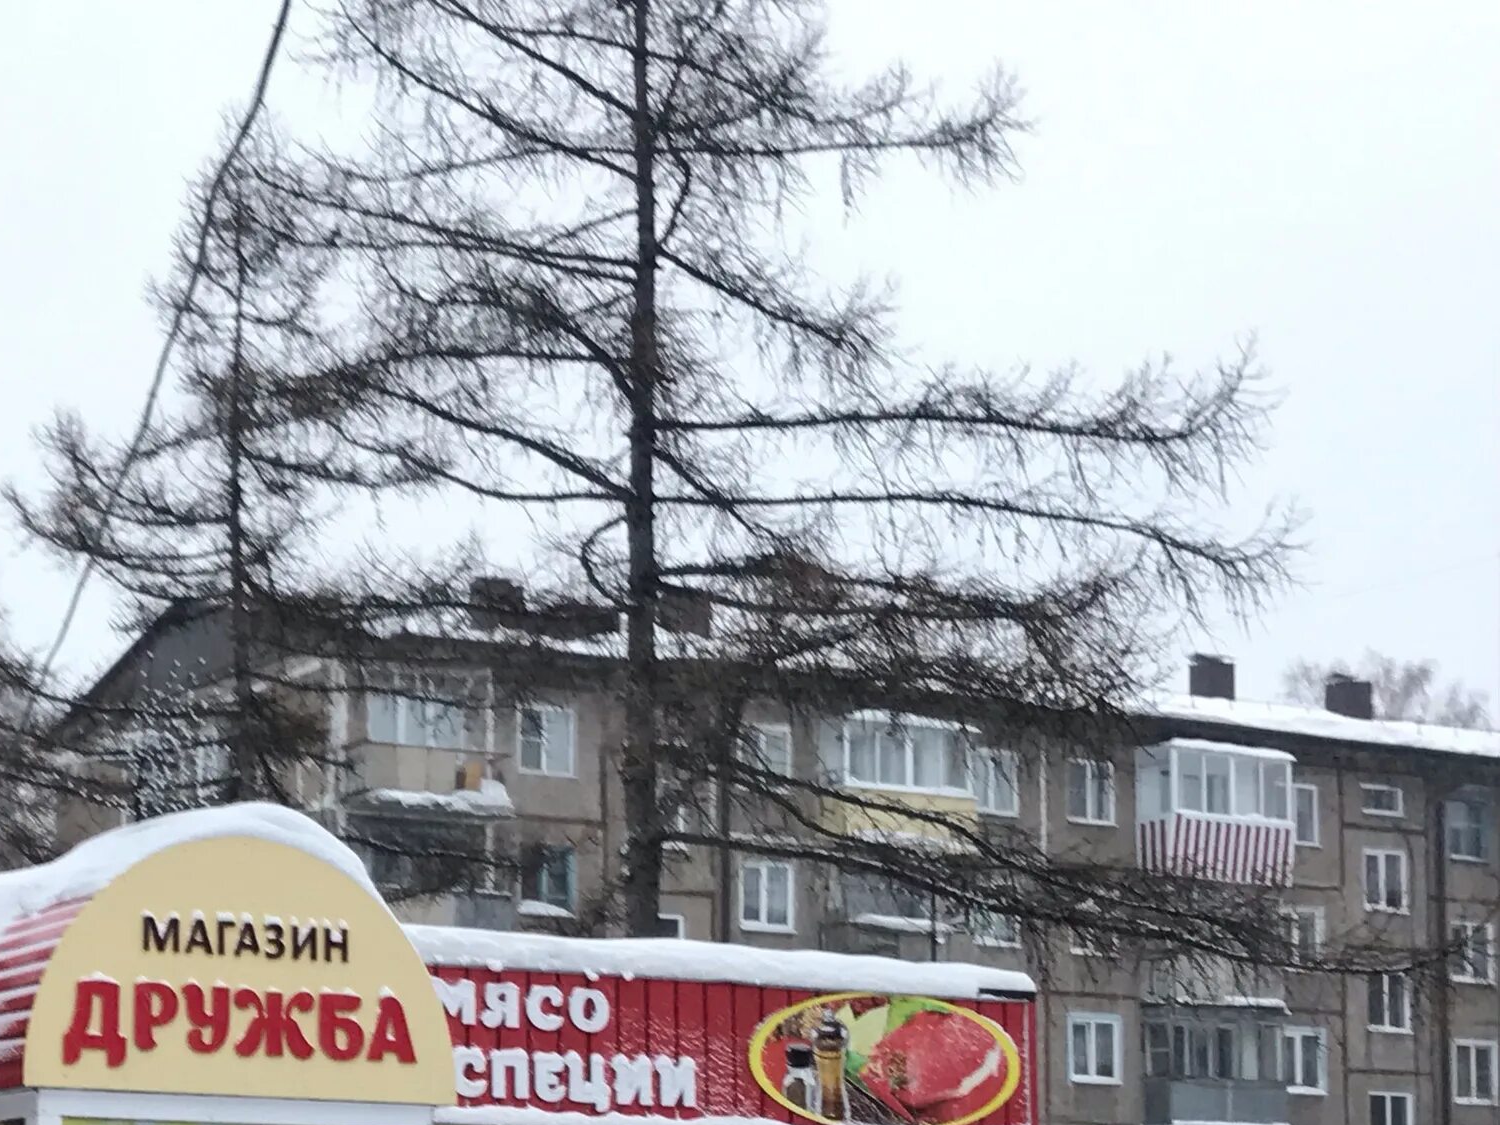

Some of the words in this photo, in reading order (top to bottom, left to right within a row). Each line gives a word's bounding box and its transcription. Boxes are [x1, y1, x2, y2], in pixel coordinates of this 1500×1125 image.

[141, 912, 350, 963] МАГАЗИН
[62, 975, 418, 1067] ДРУЖБА
[432, 975, 610, 1034] МЯСО
[453, 1045, 698, 1113] СПЕЦИИ
